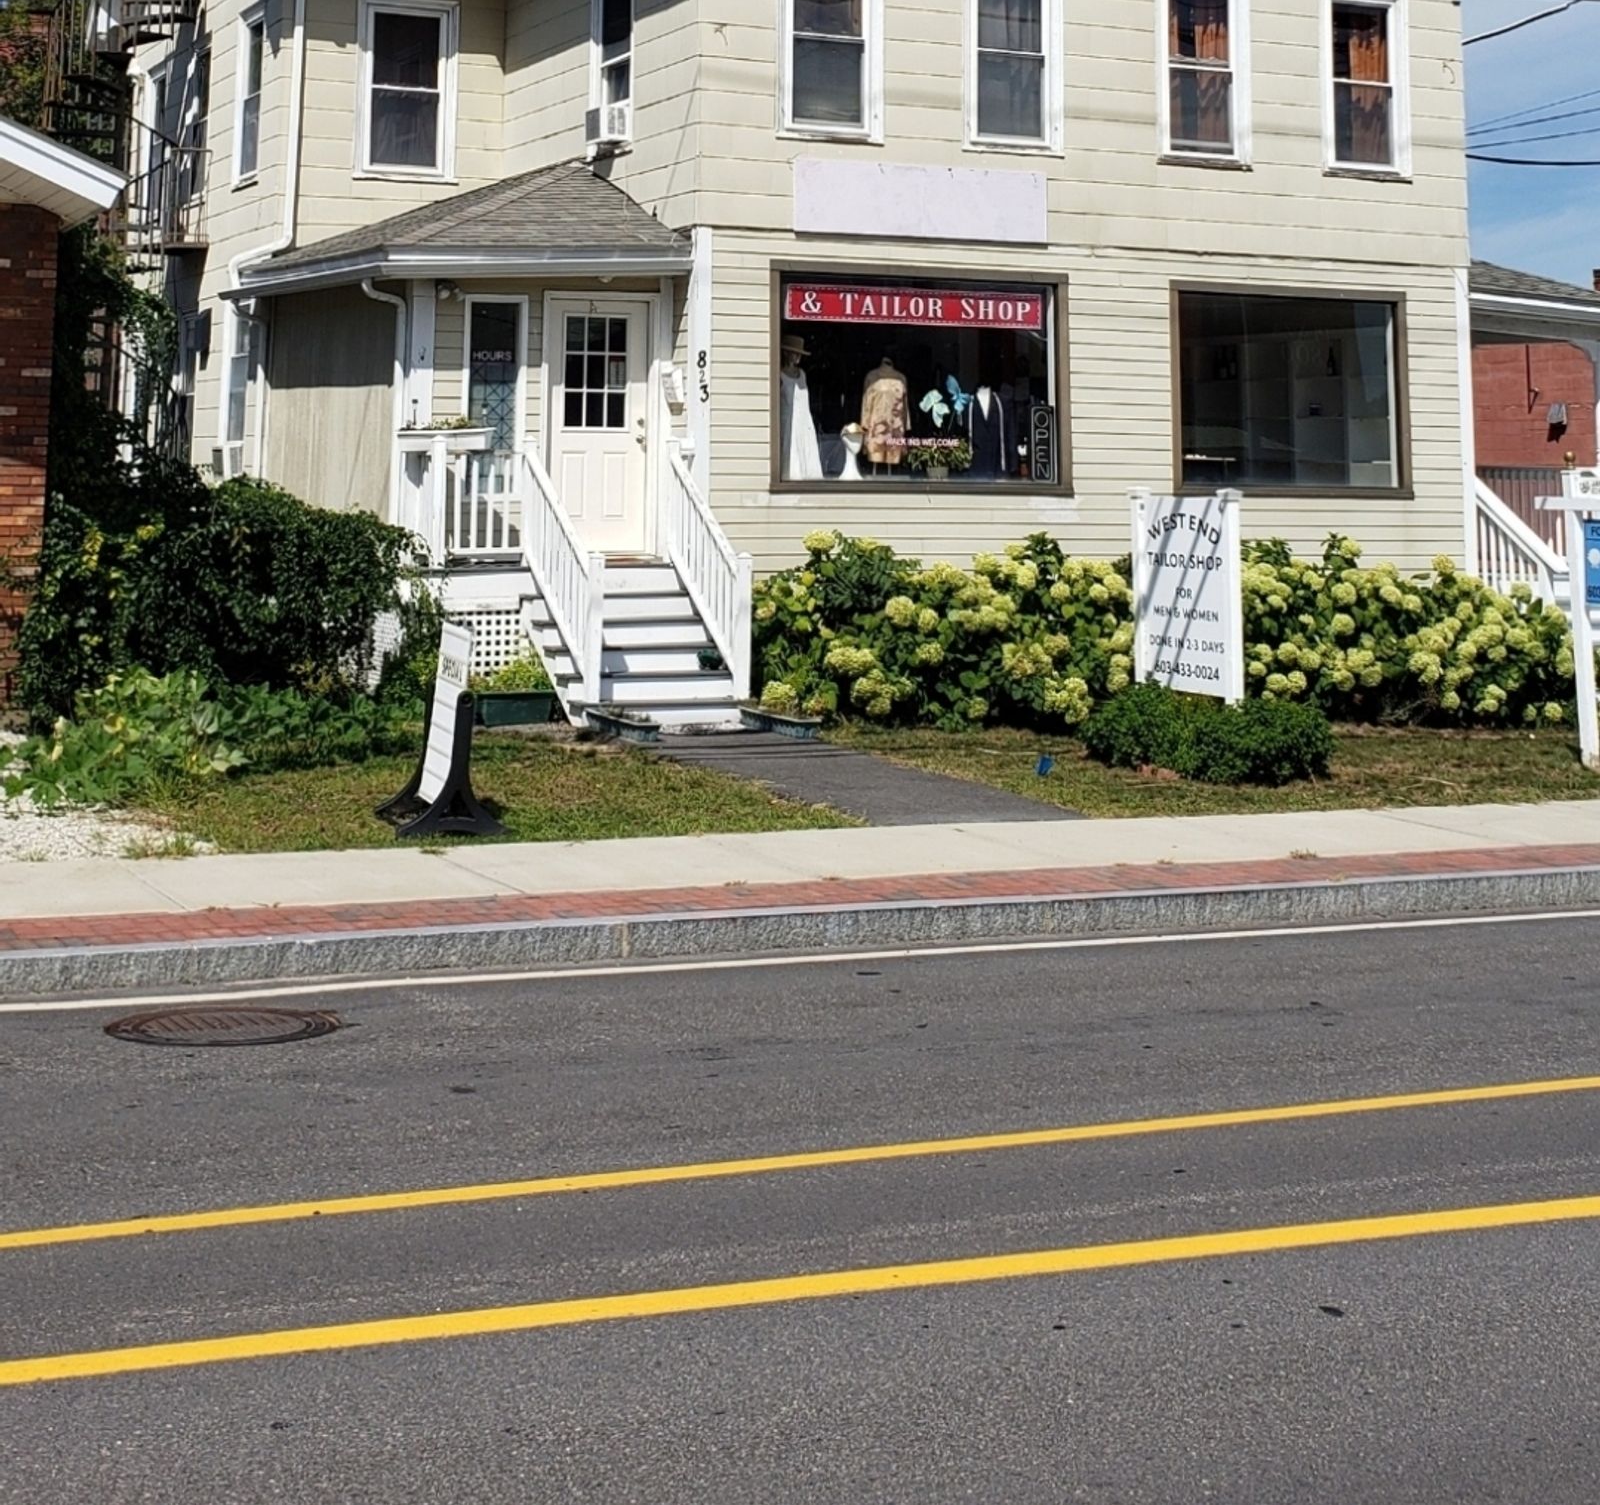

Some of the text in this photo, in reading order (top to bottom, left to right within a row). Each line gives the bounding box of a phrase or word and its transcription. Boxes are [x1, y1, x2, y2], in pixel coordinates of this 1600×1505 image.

[801, 291, 1031, 321] & TAILOR SHOP
[472, 350, 513, 362] HOURS
[696, 350, 709, 403] 823
[922, 438, 960, 447] WELCOME
[1034, 411, 1050, 479] OPEN
[1147, 513, 1220, 545] WEST END
[1147, 552, 1223, 571] TAILOR SHOP
[1175, 587, 1193, 599] FOR
[1153, 605, 1219, 622] MEN & WOMEN
[1150, 634, 1173, 647] DONE
[1175, 637, 1184, 649] IN
[1201, 641, 1225, 654] DAYS
[1154, 659, 1220, 680] 603-433-0024
